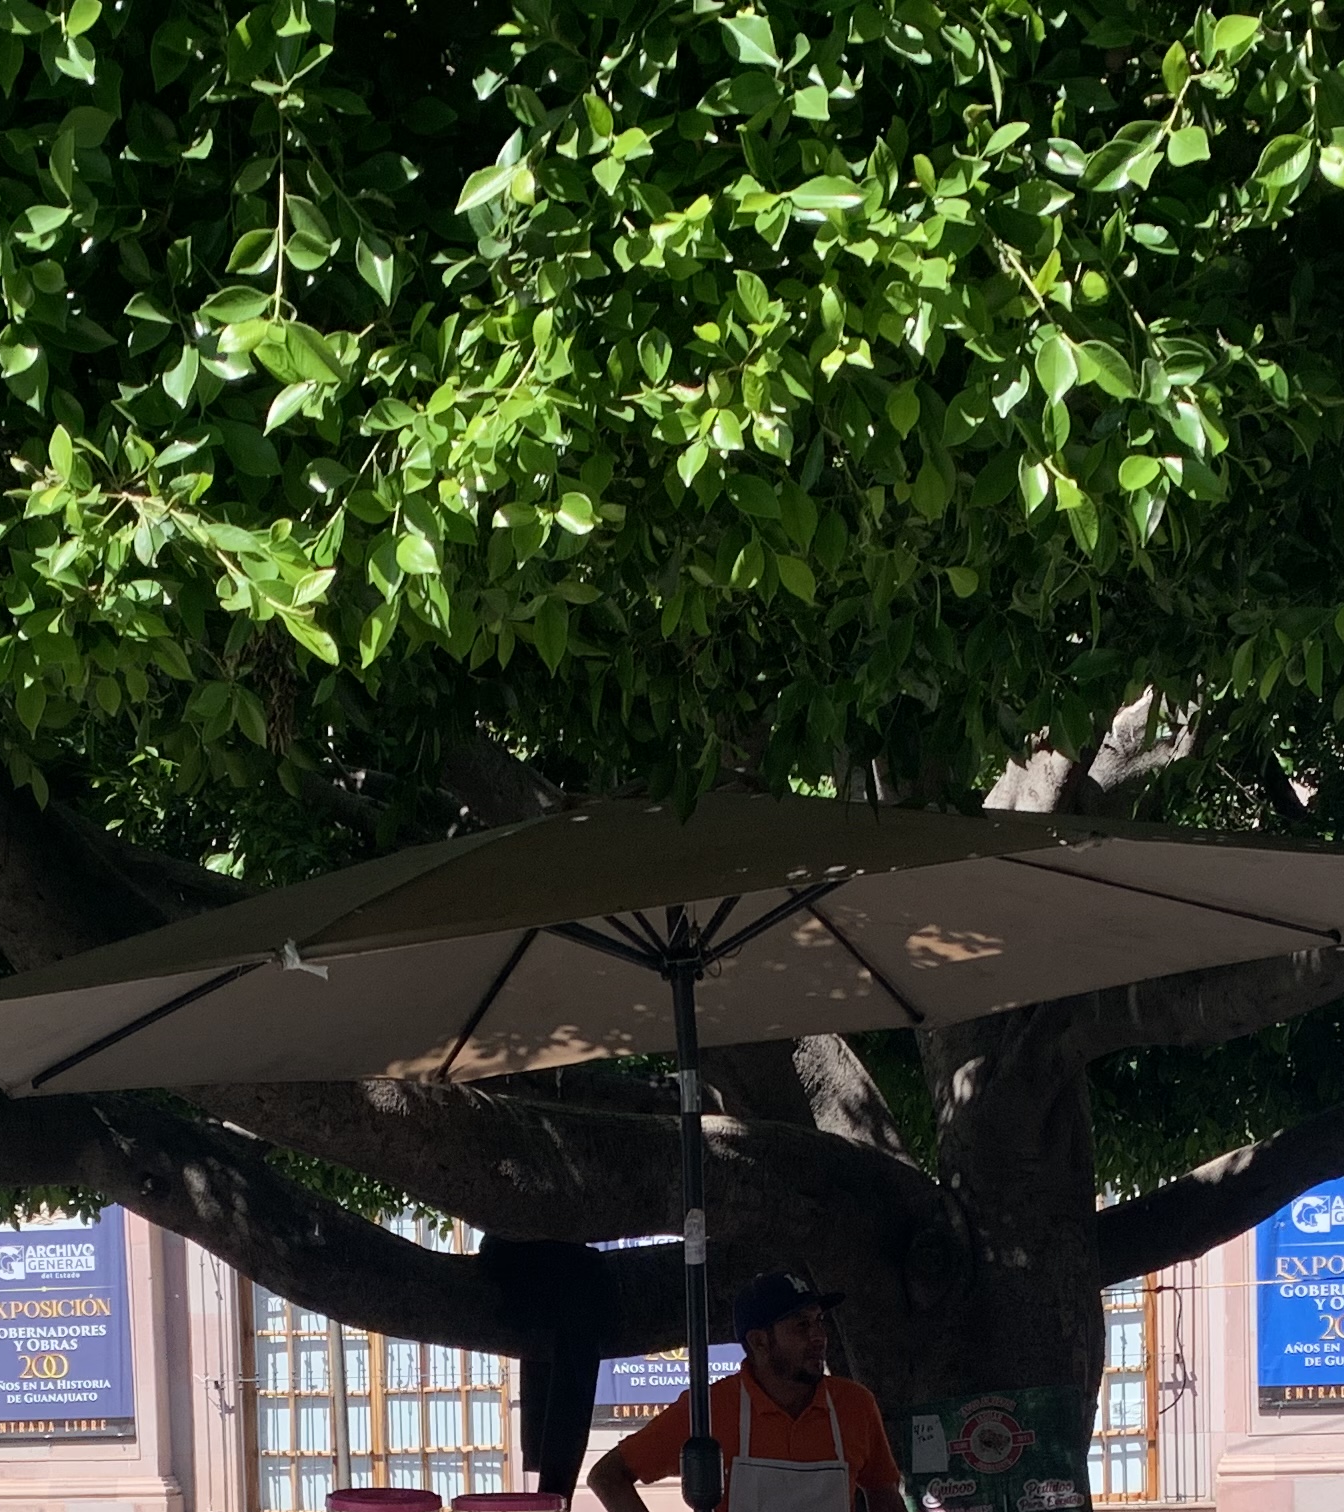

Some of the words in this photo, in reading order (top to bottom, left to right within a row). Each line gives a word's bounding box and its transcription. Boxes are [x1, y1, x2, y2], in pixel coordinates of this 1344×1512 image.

[26, 1243, 95, 1258] ARCHIVO
[28, 1257, 93, 1271] GENERAL
[55, 1271, 81, 1279] Estado
[1315, 1298, 1326, 1311] Y
[14, 1340, 25, 1351] Y
[27, 1338, 78, 1351] OBRAS
[1284, 1341, 1320, 1354] AÑOS
[1323, 1343, 1340, 1353] EN
[18, 1354, 69, 1379] 200
[612, 1361, 645, 1375] AÑOS
[648, 1363, 664, 1374] EN
[666, 1362, 682, 1373] LA
[1304, 1356, 1322, 1367] DE
[23, 1381, 37, 1391] EN
[40, 1381, 55, 1391] LA
[56, 1378, 111, 1390] HISTORIA
[630, 1375, 646, 1387] DE
[7, 1393, 22, 1404] DE
[23, 1391, 98, 1404] GUANAJUATO
[65, 1419, 107, 1432] LIBRE
